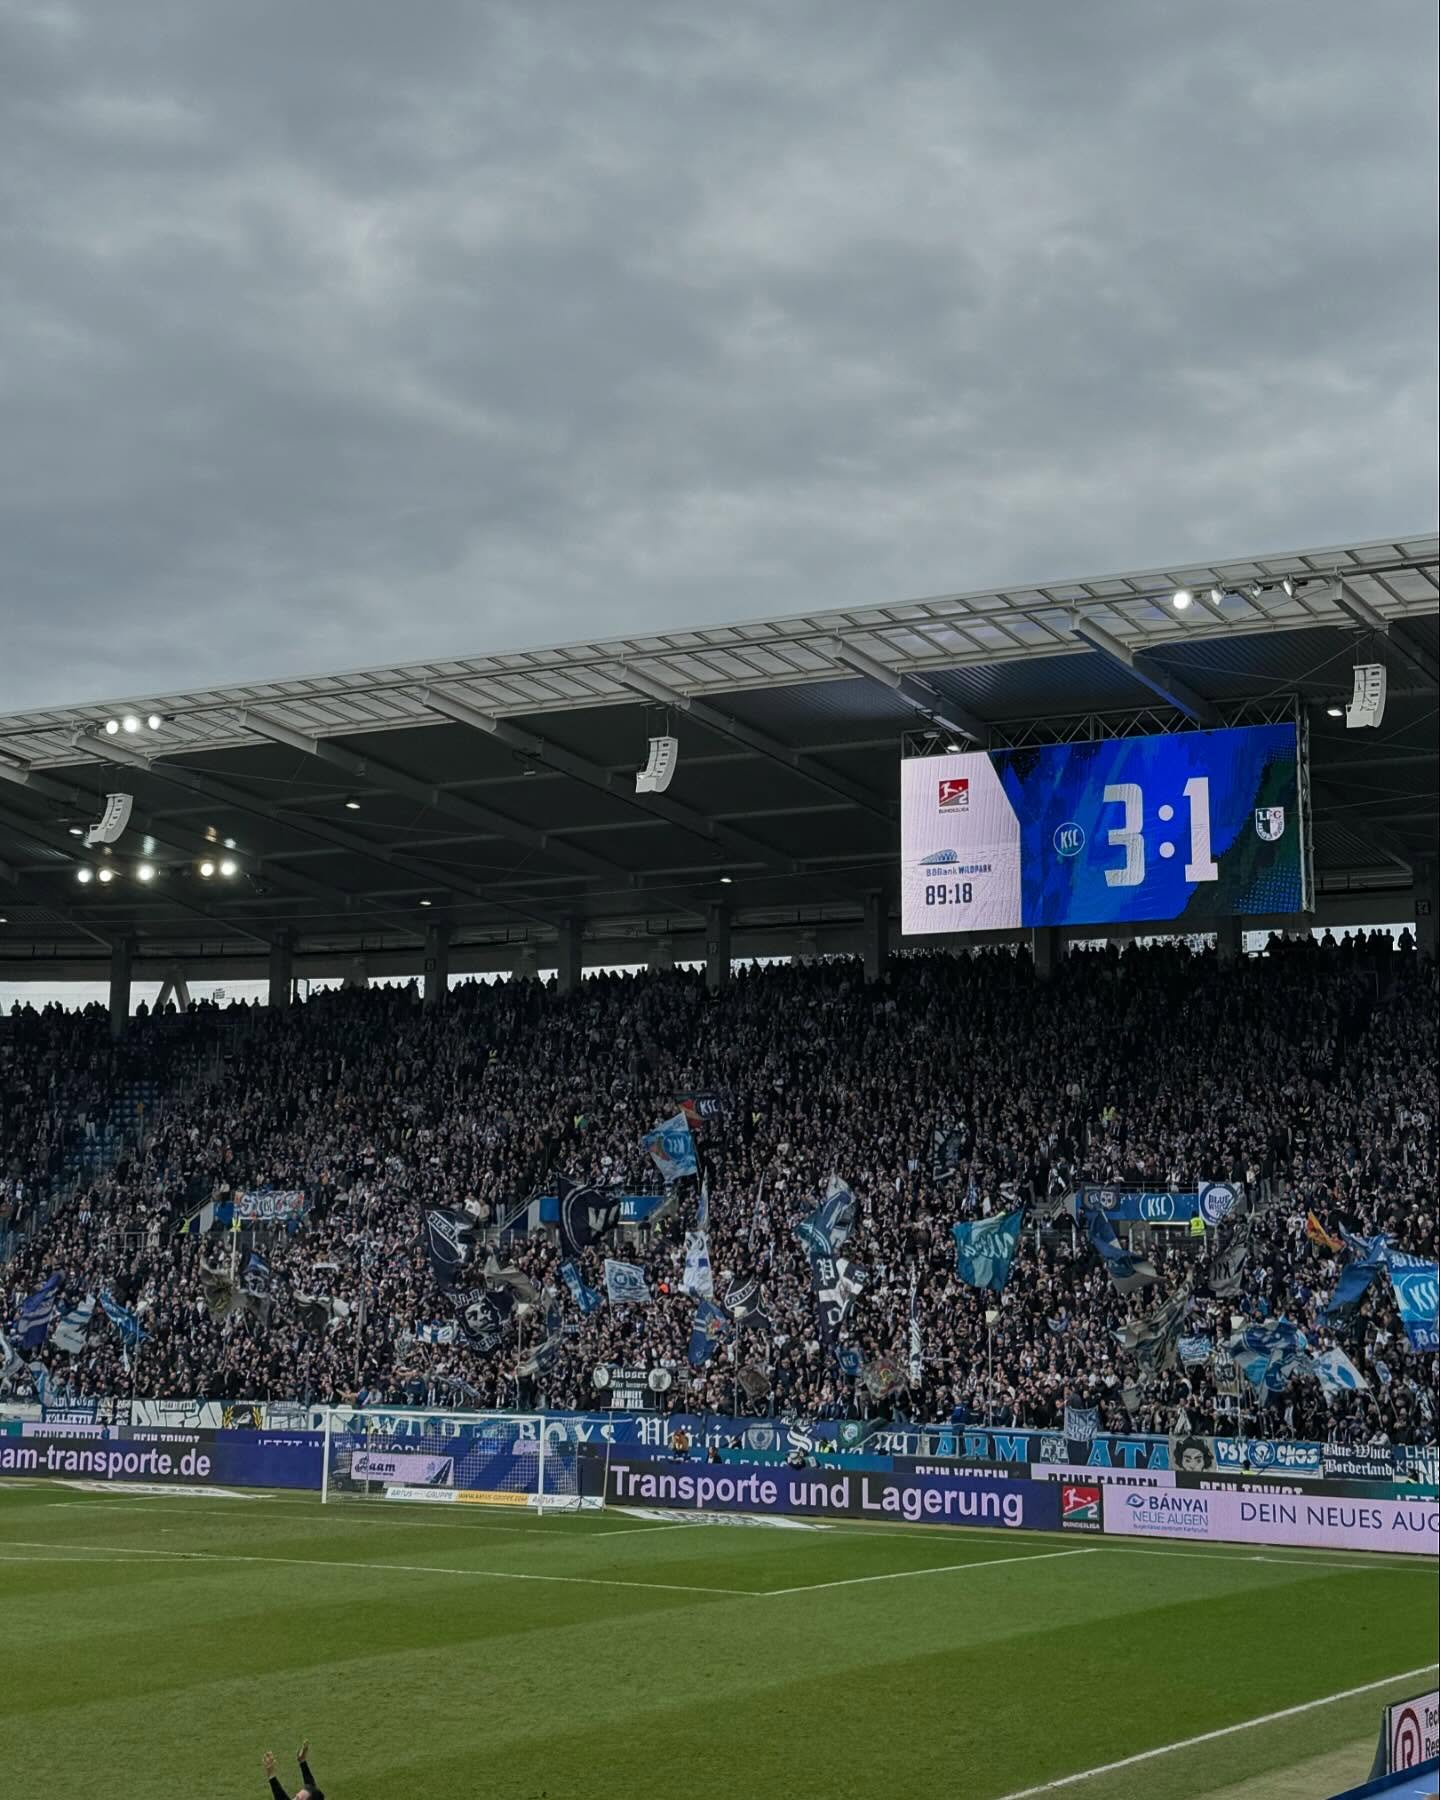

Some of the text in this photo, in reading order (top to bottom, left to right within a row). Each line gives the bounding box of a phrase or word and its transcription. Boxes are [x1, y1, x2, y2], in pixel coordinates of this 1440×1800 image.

[1060, 829, 1079, 849] KSC
[1103, 776, 1219, 887] 3:1
[925, 882, 973, 905] 89:18
[1149, 1195, 1167, 1217] KSC
[0, 1444, 211, 1479] am-transporte.de
[610, 1465, 1024, 1527] Transporte und Lagerung
[1149, 1493, 1208, 1513] BÁNYAI
[1086, 1504, 1099, 1519] 2
[1132, 1511, 1209, 1526] NEUE AUGEN
[1240, 1502, 1297, 1525] DEIN
[1307, 1506, 1383, 1530] NEUES
[1062, 1521, 1100, 1530] BUNDESLIGA
